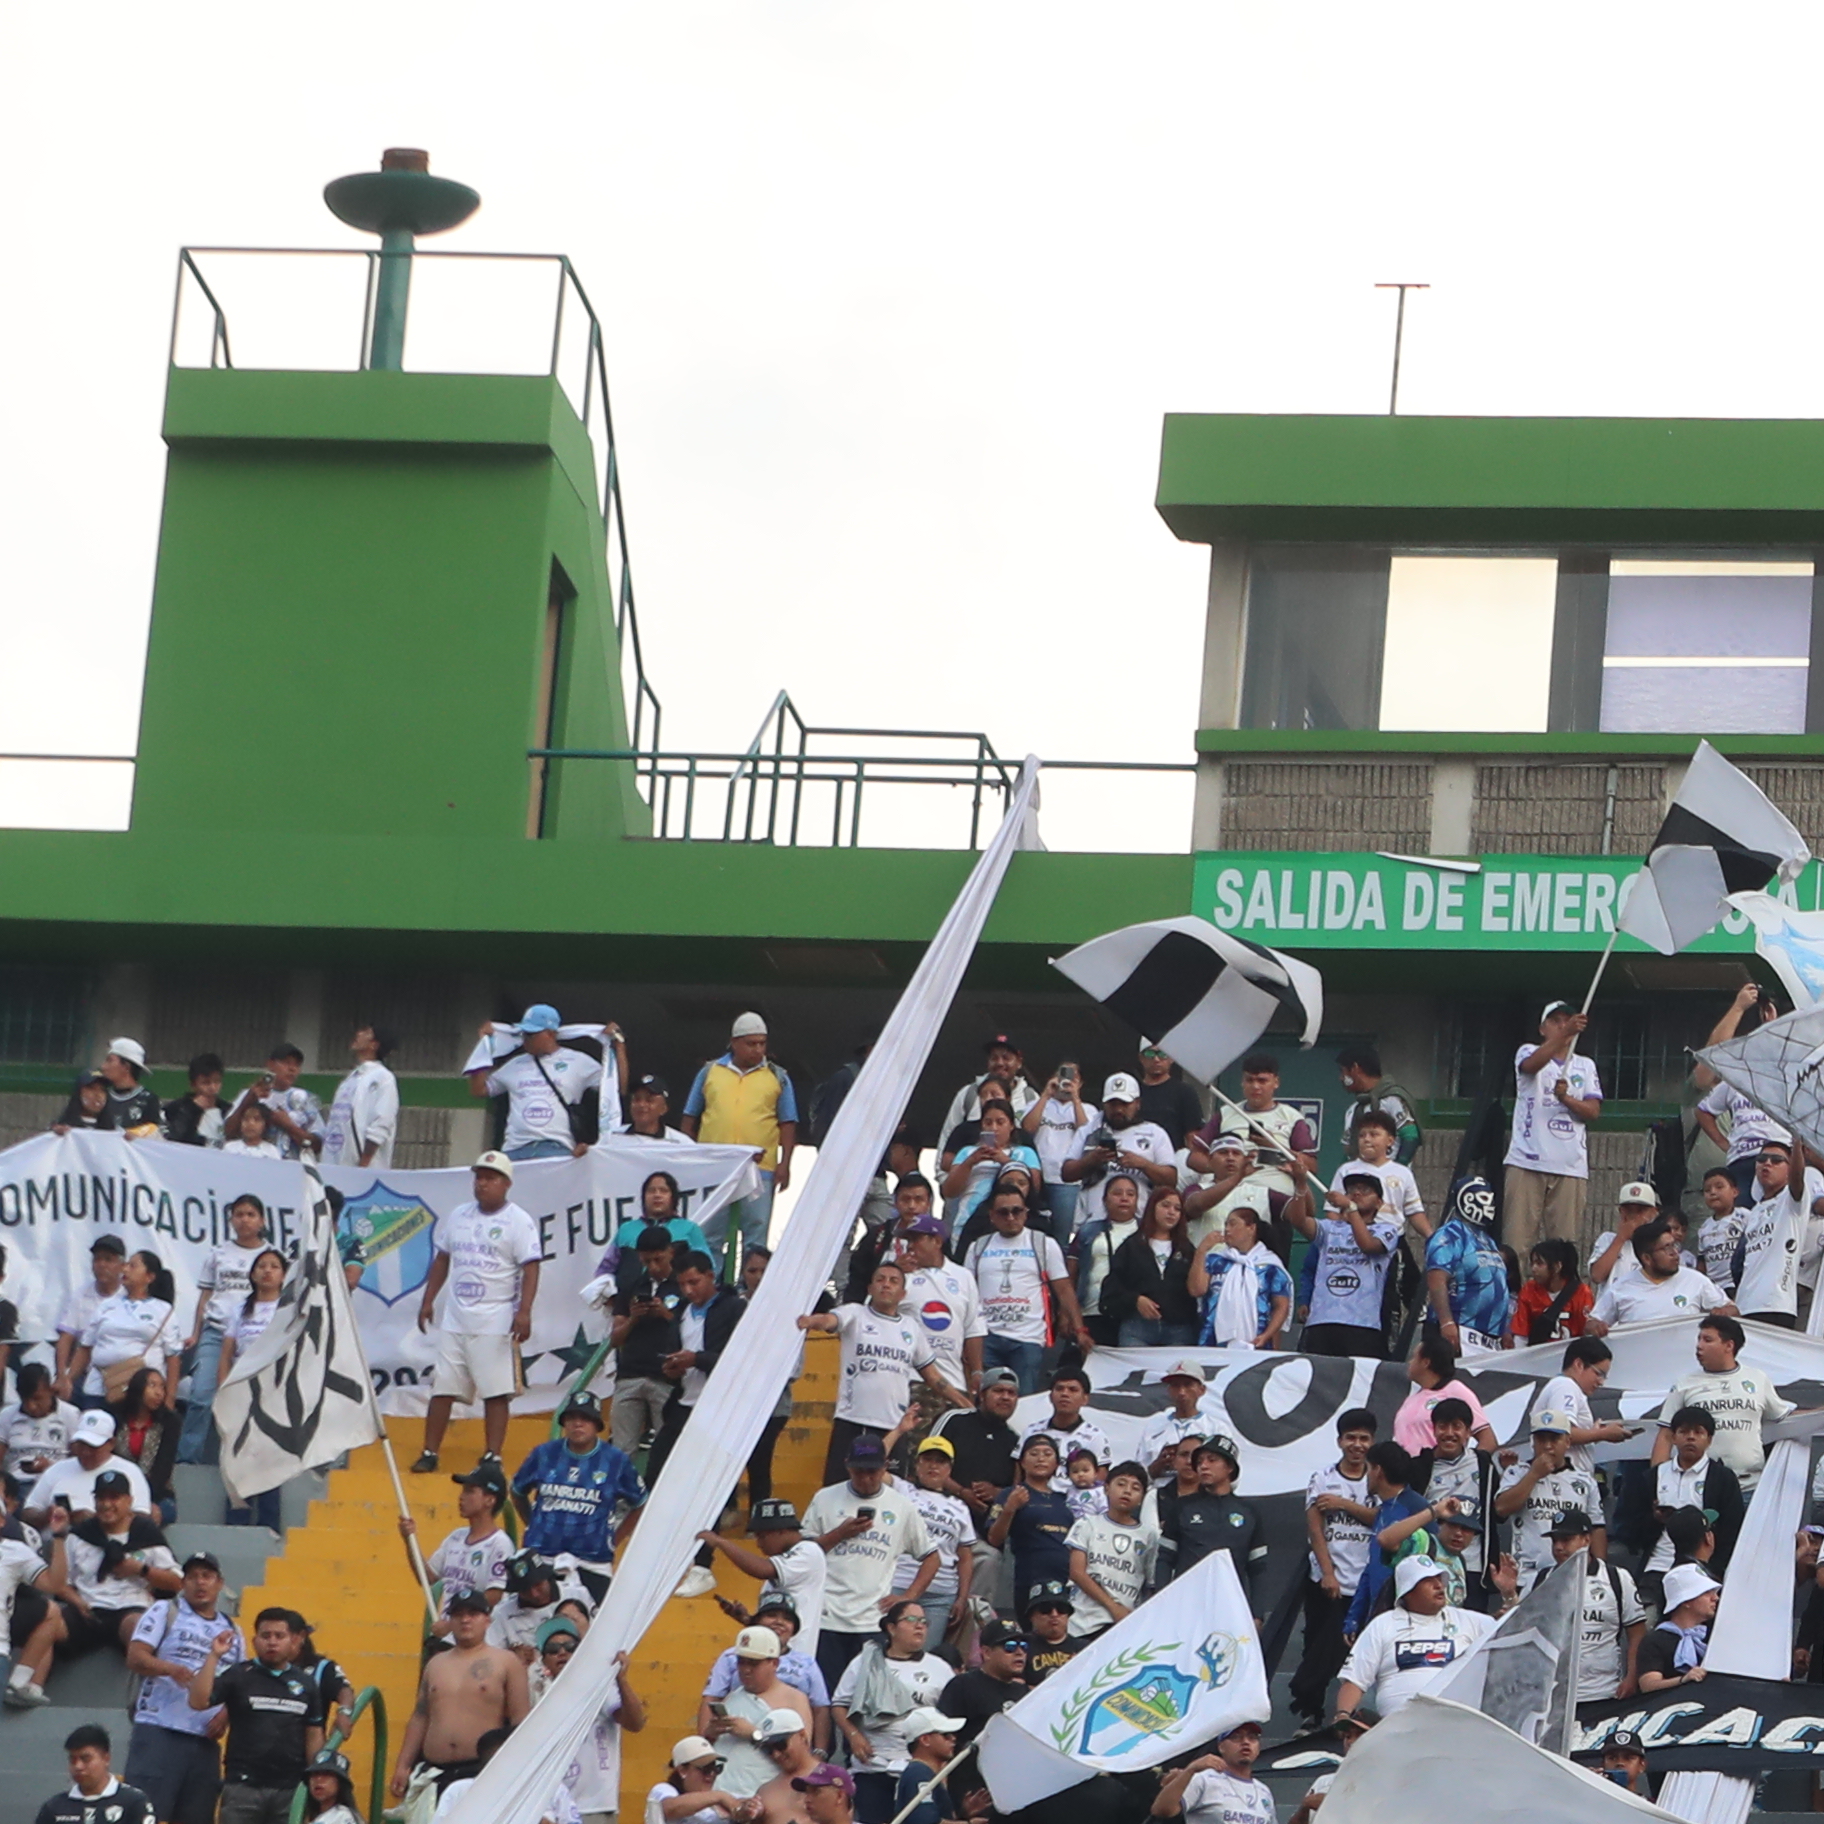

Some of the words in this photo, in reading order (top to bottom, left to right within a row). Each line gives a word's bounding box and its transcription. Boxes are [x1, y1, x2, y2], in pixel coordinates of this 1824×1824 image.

[1213, 867, 1388, 932] SALIDA
[1402, 870, 1465, 931] DE
[1326, 1274, 1360, 1291] Gulf
[856, 1343, 911, 1364] BANRURA
[1399, 1641, 1452, 1656] PEPSI
